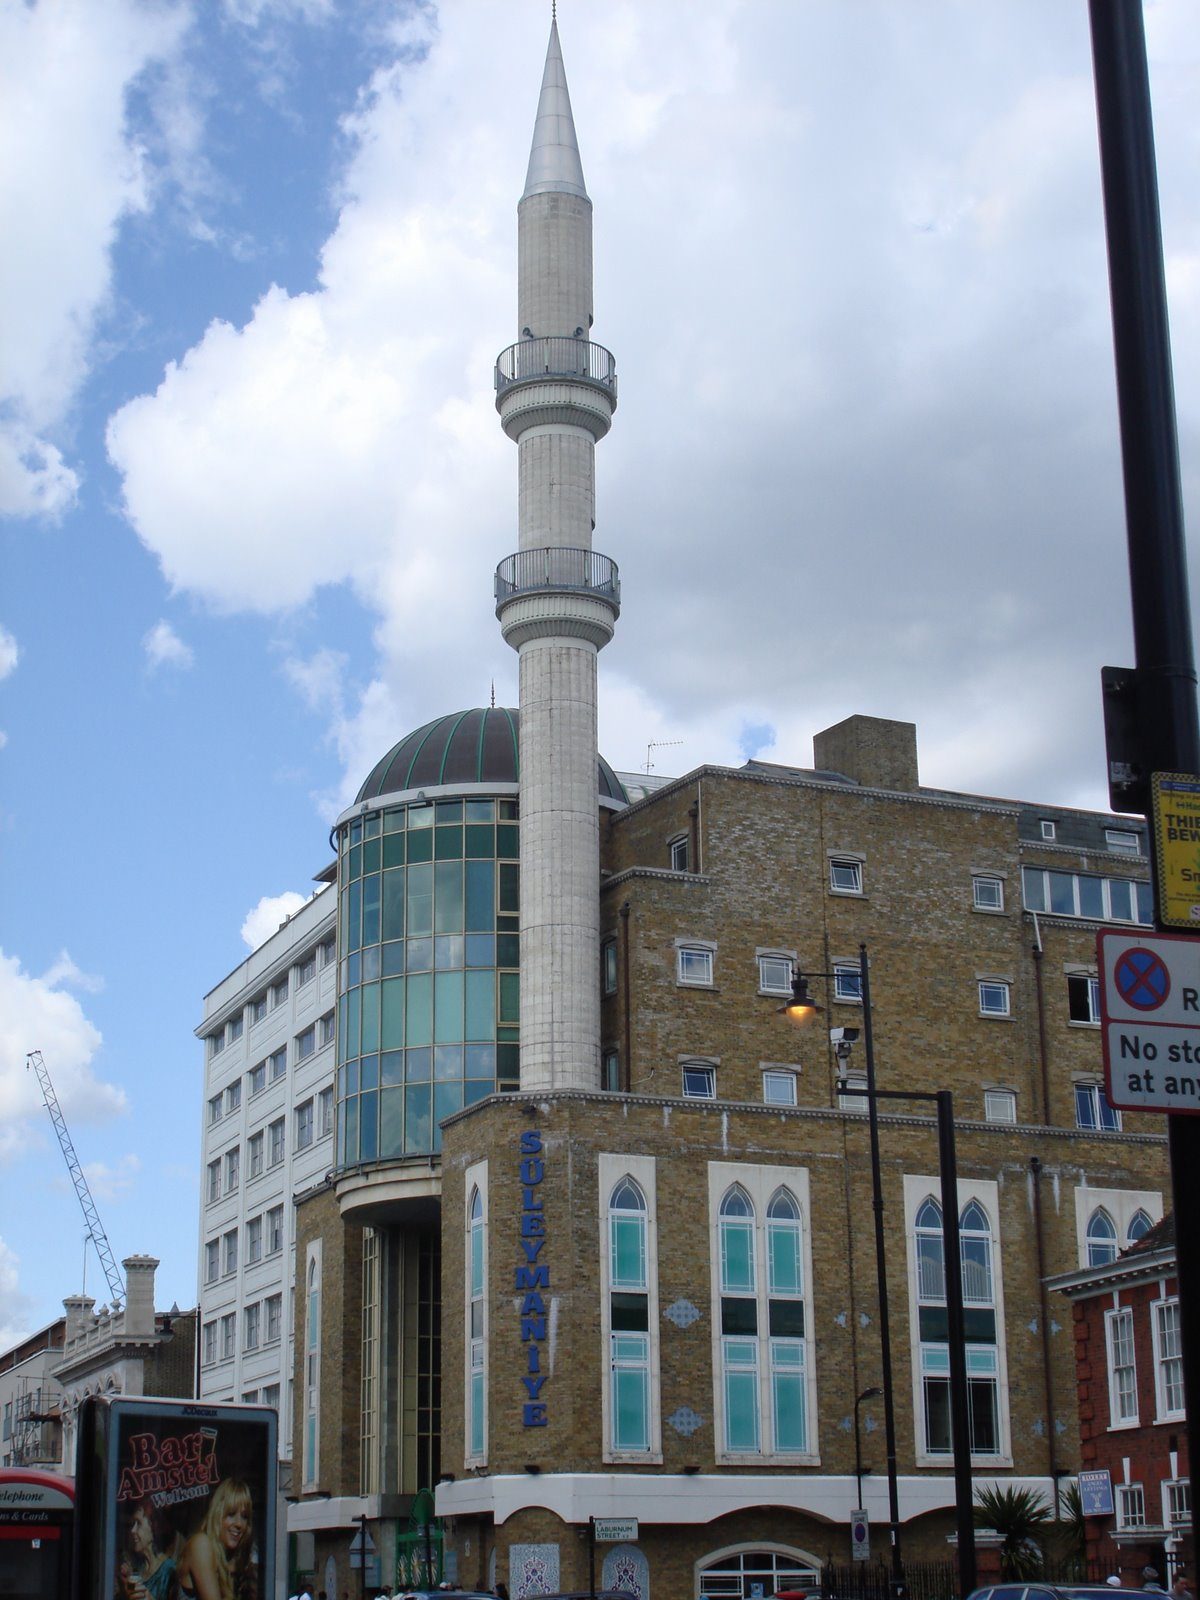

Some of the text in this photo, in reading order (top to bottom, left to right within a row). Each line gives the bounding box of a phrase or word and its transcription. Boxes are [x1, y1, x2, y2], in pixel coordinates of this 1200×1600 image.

[1121, 1035, 1157, 1060] No
[1129, 1070, 1200, 1101] at an
[181, 1407, 217, 1416] JCDecaux
[129, 1432, 202, 1472] Bar
[117, 1453, 220, 1502] Amstel
[151, 1484, 209, 1509] Welkom
[22, 1512, 49, 1520] Cards
